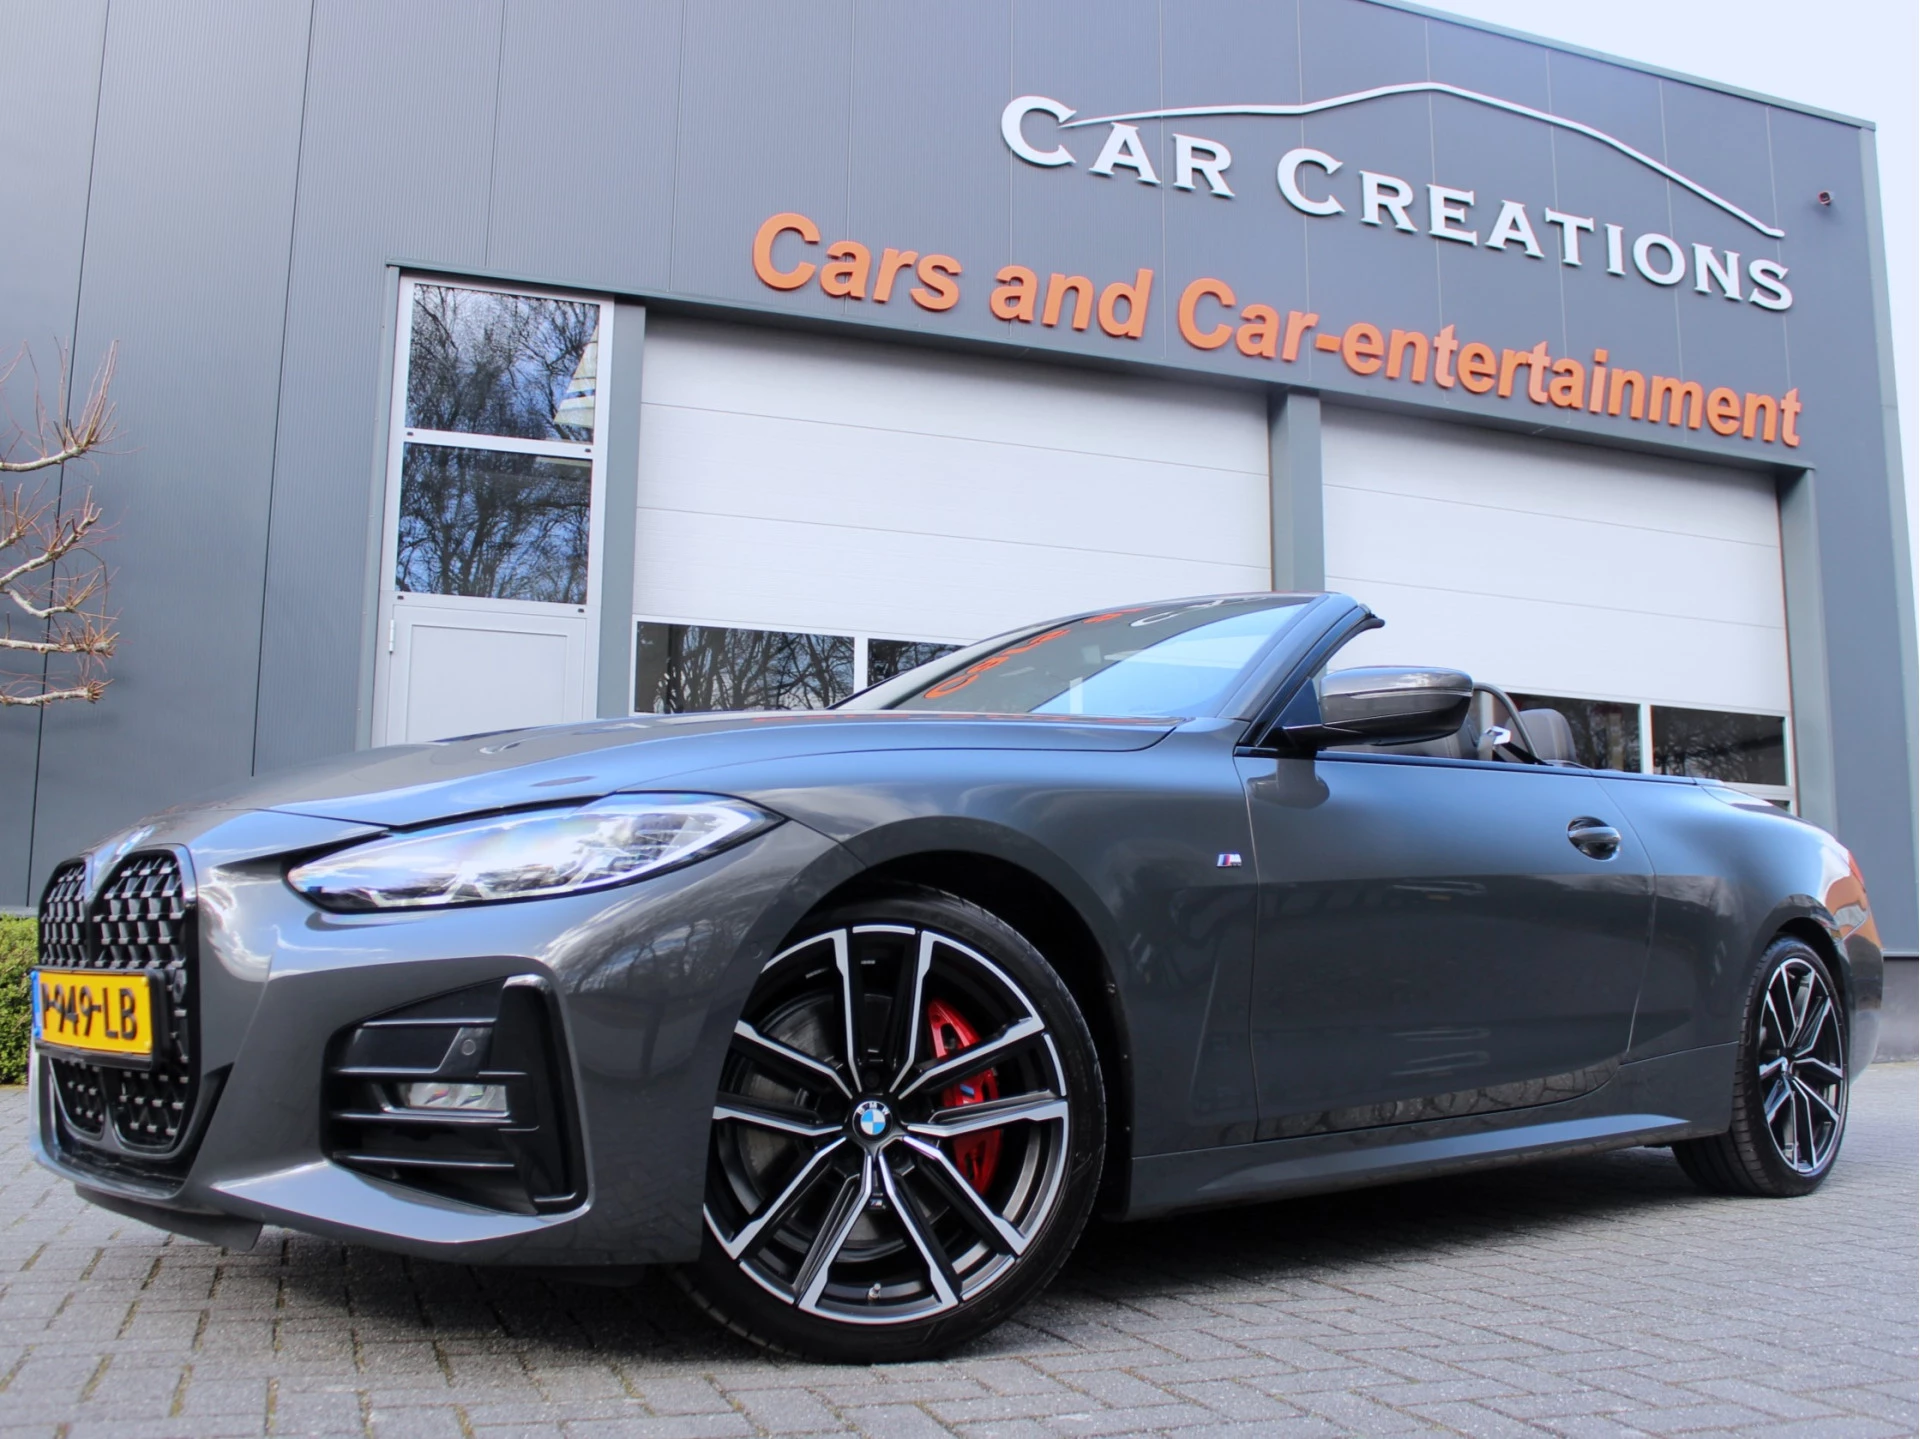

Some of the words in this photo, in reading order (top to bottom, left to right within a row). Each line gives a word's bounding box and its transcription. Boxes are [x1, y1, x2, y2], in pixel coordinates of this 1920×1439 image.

[1001, 95, 1234, 197] CAR
[1277, 149, 1794, 310] CREATIONS
[752, 213, 962, 311] Cars
[989, 266, 1153, 339] and
[1178, 278, 1802, 447] Car-entertainment
